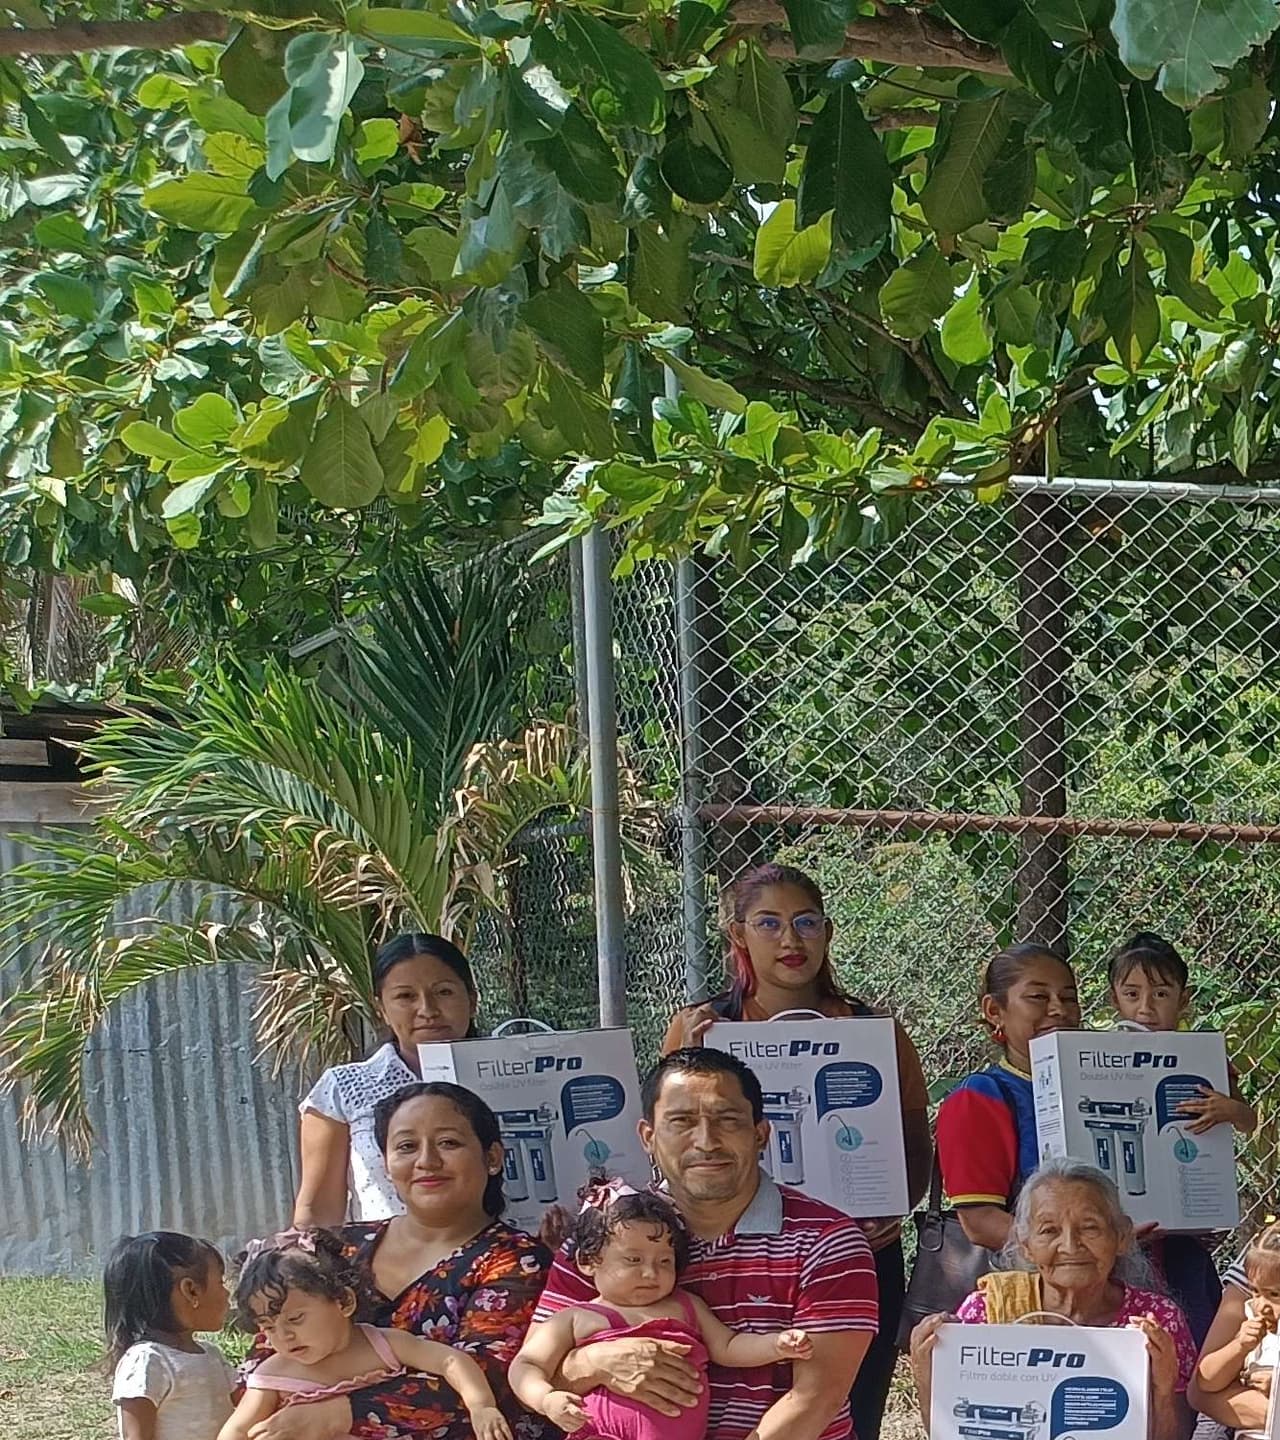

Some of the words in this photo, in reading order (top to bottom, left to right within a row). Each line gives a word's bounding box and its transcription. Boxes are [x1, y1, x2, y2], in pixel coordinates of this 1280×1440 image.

[729, 1040, 840, 1058] FilterPro
[476, 1055, 582, 1079] FilterPro
[1079, 1051, 1178, 1068] FilterPro
[960, 1346, 1086, 1368] FilterPro
[990, 1371, 1018, 1381] doble
[1020, 1373, 1038, 1381] con
